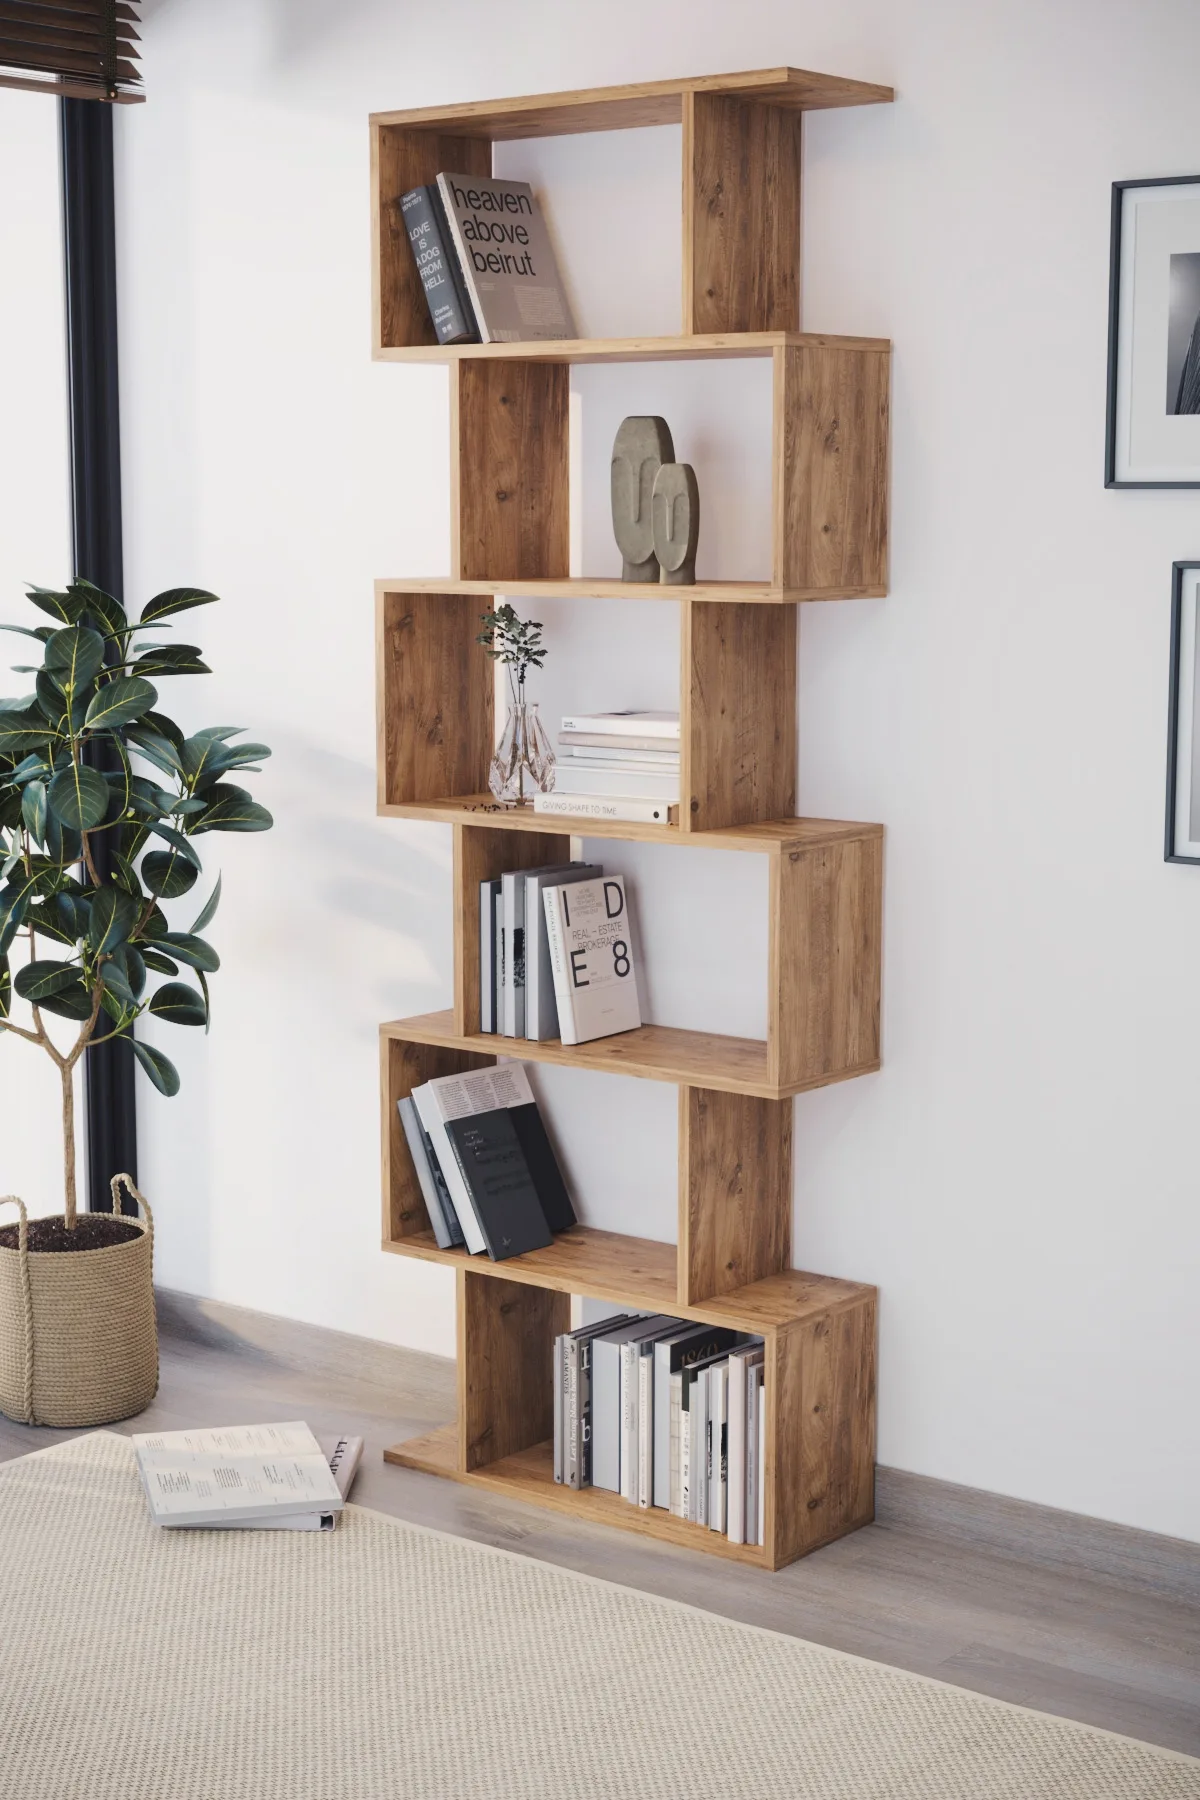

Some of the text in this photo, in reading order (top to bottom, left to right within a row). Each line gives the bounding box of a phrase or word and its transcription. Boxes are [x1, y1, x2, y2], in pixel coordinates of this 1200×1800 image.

[450, 181, 532, 215] heaven
[409, 221, 430, 240] LOVE
[463, 214, 529, 245] above
[418, 238, 428, 250] IS
[416, 246, 440, 267] A DOG
[469, 244, 536, 276] beirut
[420, 259, 442, 279] FROM
[424, 274, 445, 291] HELL
[542, 800, 617, 815] GIVING SHAPE TO TIME
[562, 890, 570, 927] I
[603, 881, 624, 918] D
[572, 929, 590, 940] REAL
[598, 921, 623, 936] ESTATE
[577, 935, 620, 951] BROKERAGE
[570, 940, 631, 988] E 8
